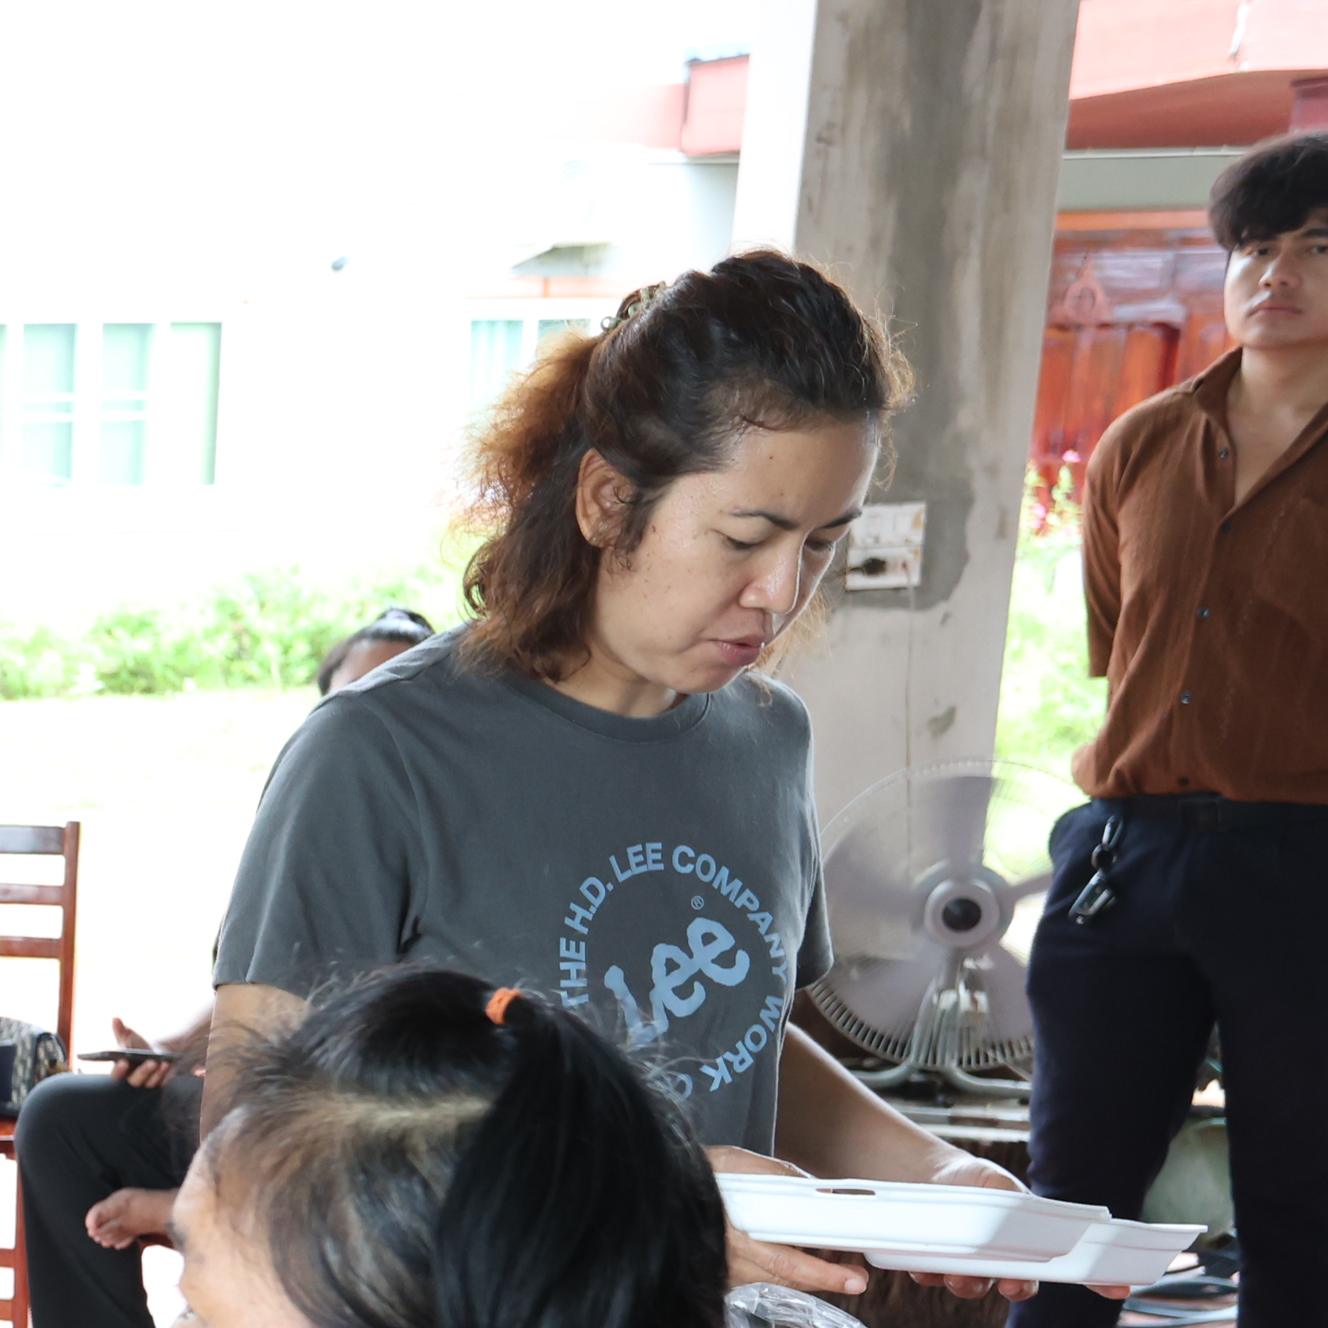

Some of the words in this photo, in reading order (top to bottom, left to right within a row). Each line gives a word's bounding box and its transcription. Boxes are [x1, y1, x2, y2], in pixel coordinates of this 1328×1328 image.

[609, 842, 665, 883] LEE
[564, 876, 614, 935] H.D.
[672, 844, 790, 987] COMPANY
[559, 937, 590, 1009] THE
[604, 917, 751, 1052] Lee
[699, 995, 785, 1092] WORK
